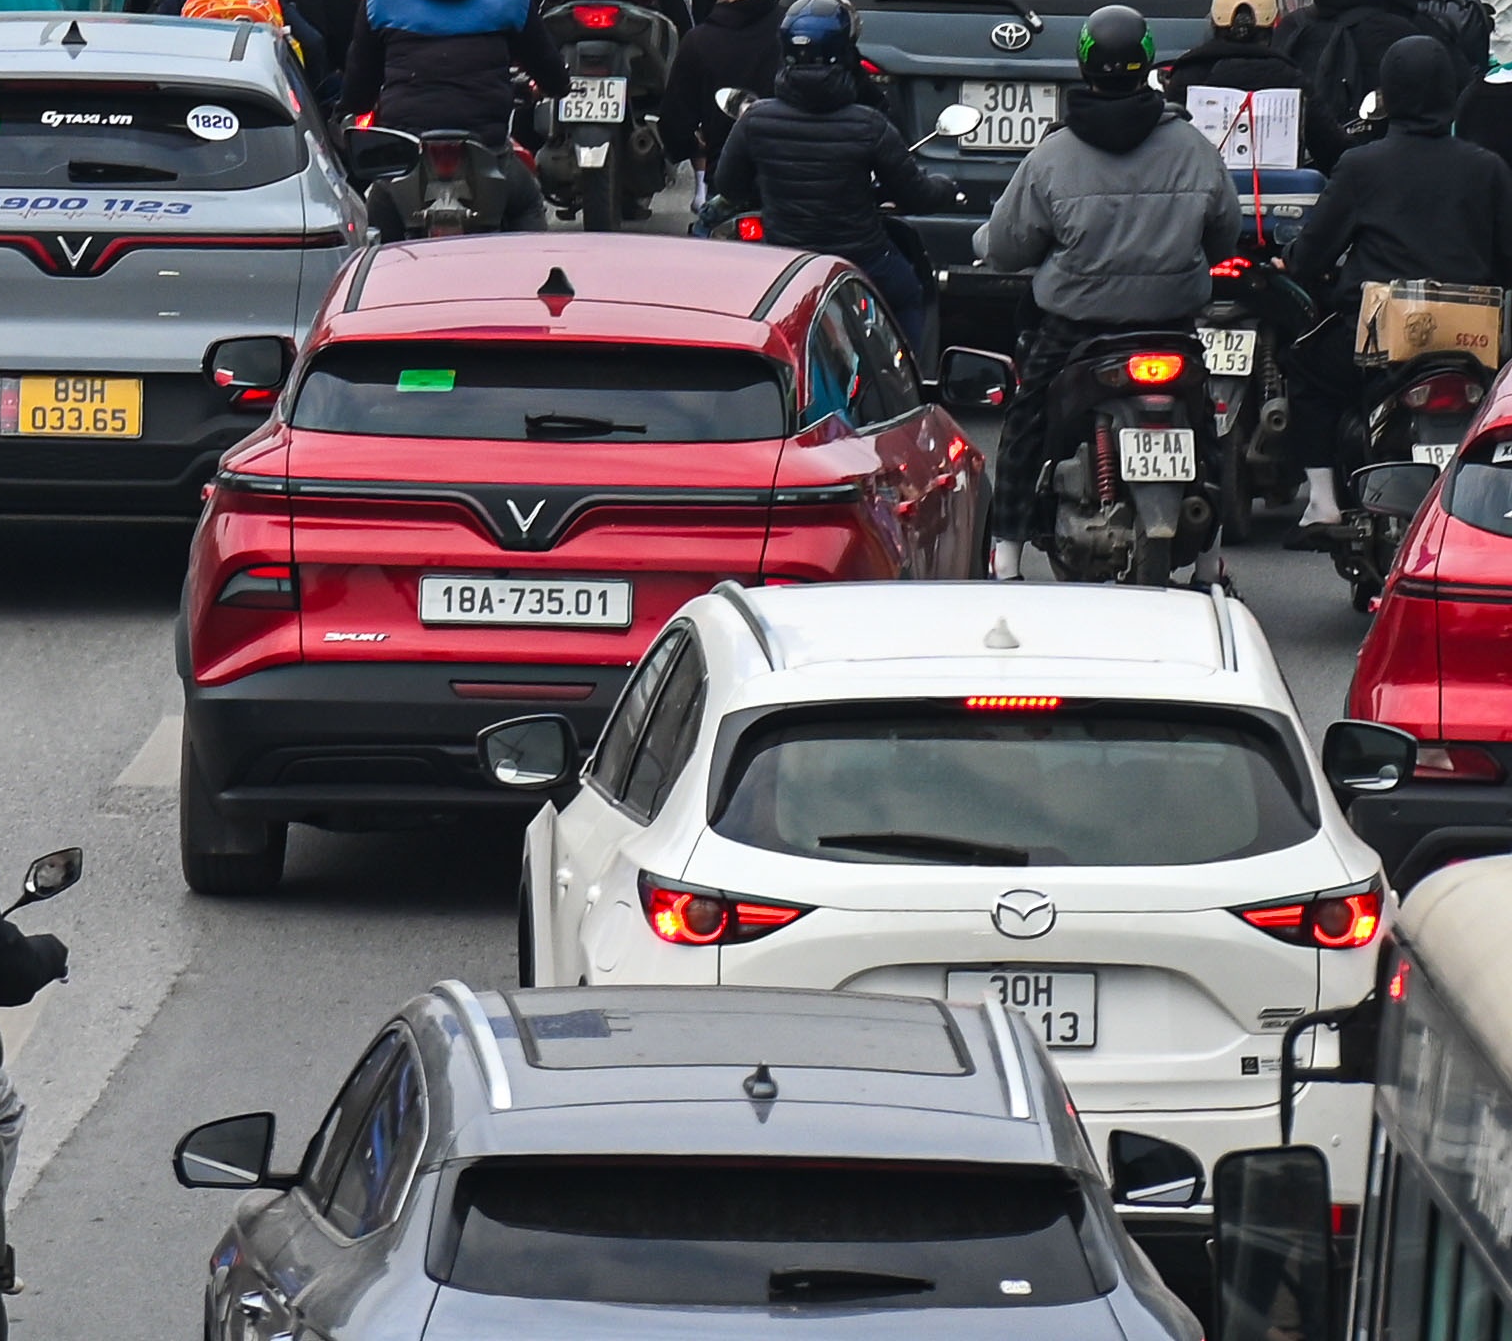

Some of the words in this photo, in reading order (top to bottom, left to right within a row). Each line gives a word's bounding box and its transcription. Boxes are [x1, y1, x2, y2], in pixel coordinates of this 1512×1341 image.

[564, 100, 620, 119] 652.93
[983, 83, 1034, 113] 30A
[191, 113, 235, 131] 1820
[101, 198, 192, 217] 1123
[1456, 333, 1489, 348] GX35
[55, 379, 106, 403] 89H
[32, 406, 127, 432] 033.65
[1133, 432, 1183, 454] 18-AA
[1127, 455, 1191, 478] 434.14
[442, 584, 610, 617] 18A-735.01
[990, 975, 1053, 1007] 30H
